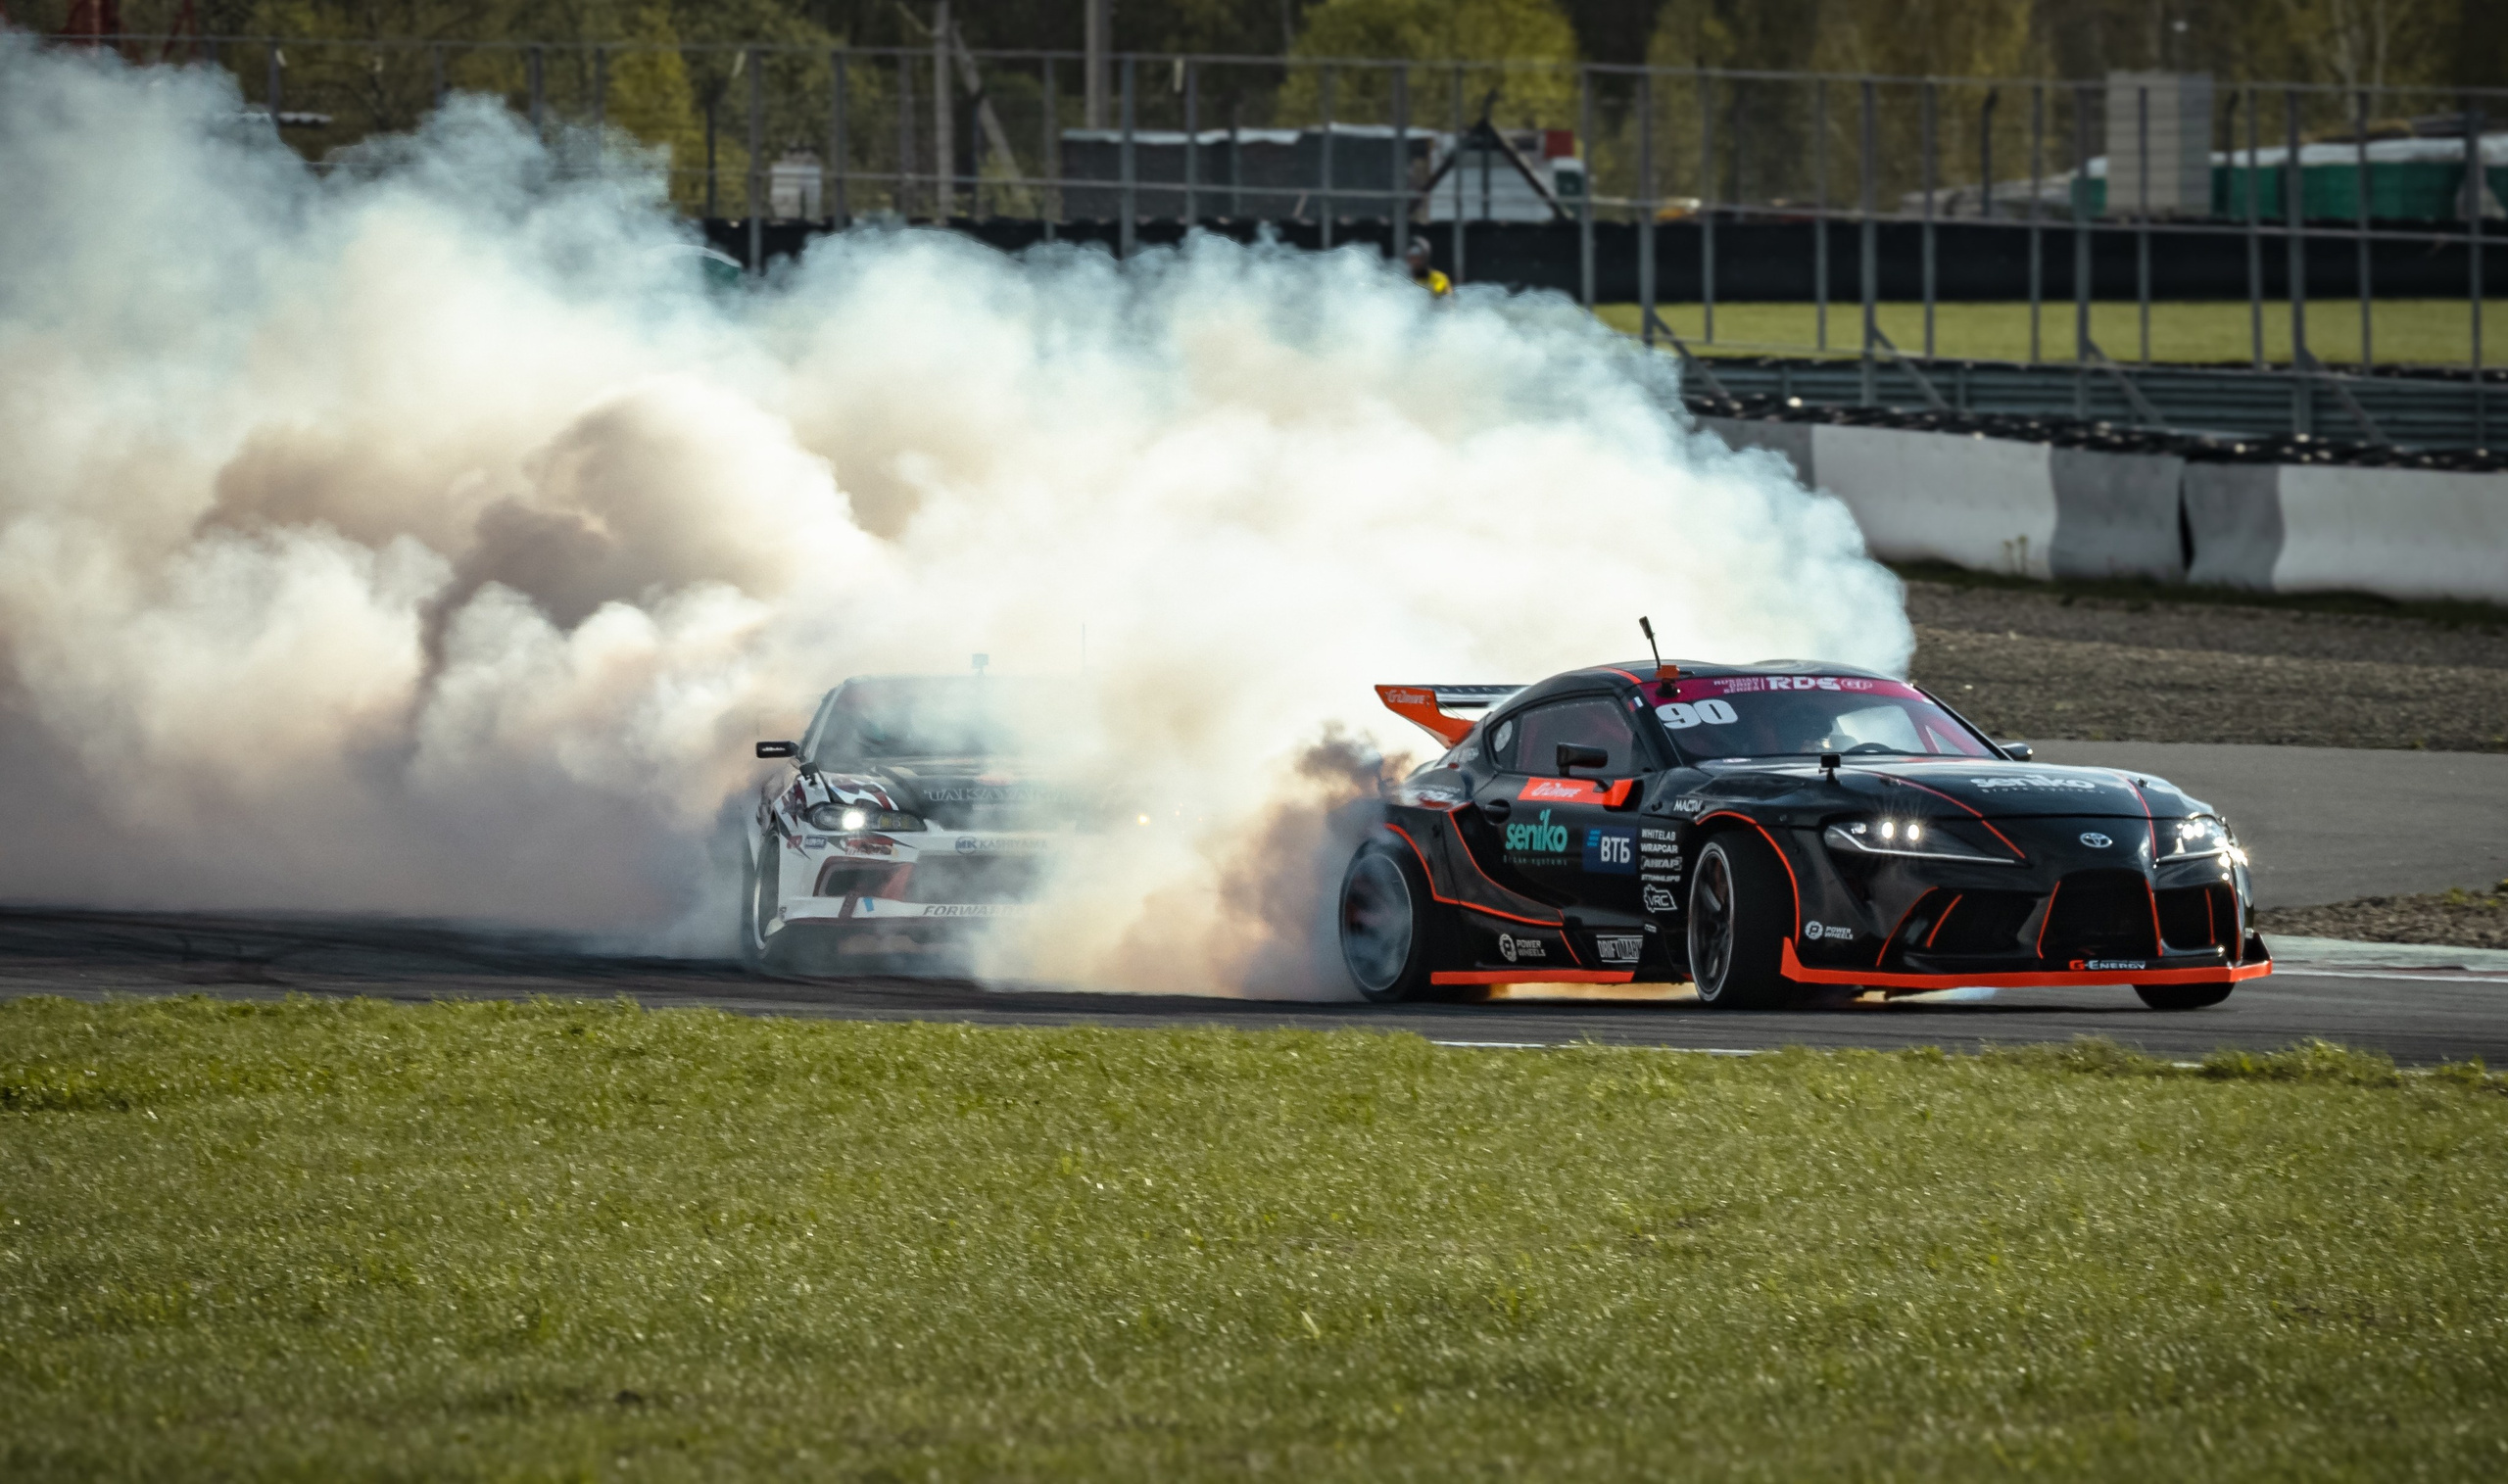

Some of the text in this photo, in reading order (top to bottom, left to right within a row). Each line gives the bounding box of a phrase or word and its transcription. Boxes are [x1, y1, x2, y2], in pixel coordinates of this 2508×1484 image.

[1655, 698, 1739, 730] 90
[1505, 809, 1568, 852] seniko
[1641, 829, 1676, 841] WHITELAB
[1640, 843, 1679, 854] WRAPCAR
[1647, 894, 1669, 907] VRC
[1516, 939, 1541, 948] POWER
[1518, 948, 1546, 957] WHEELS
